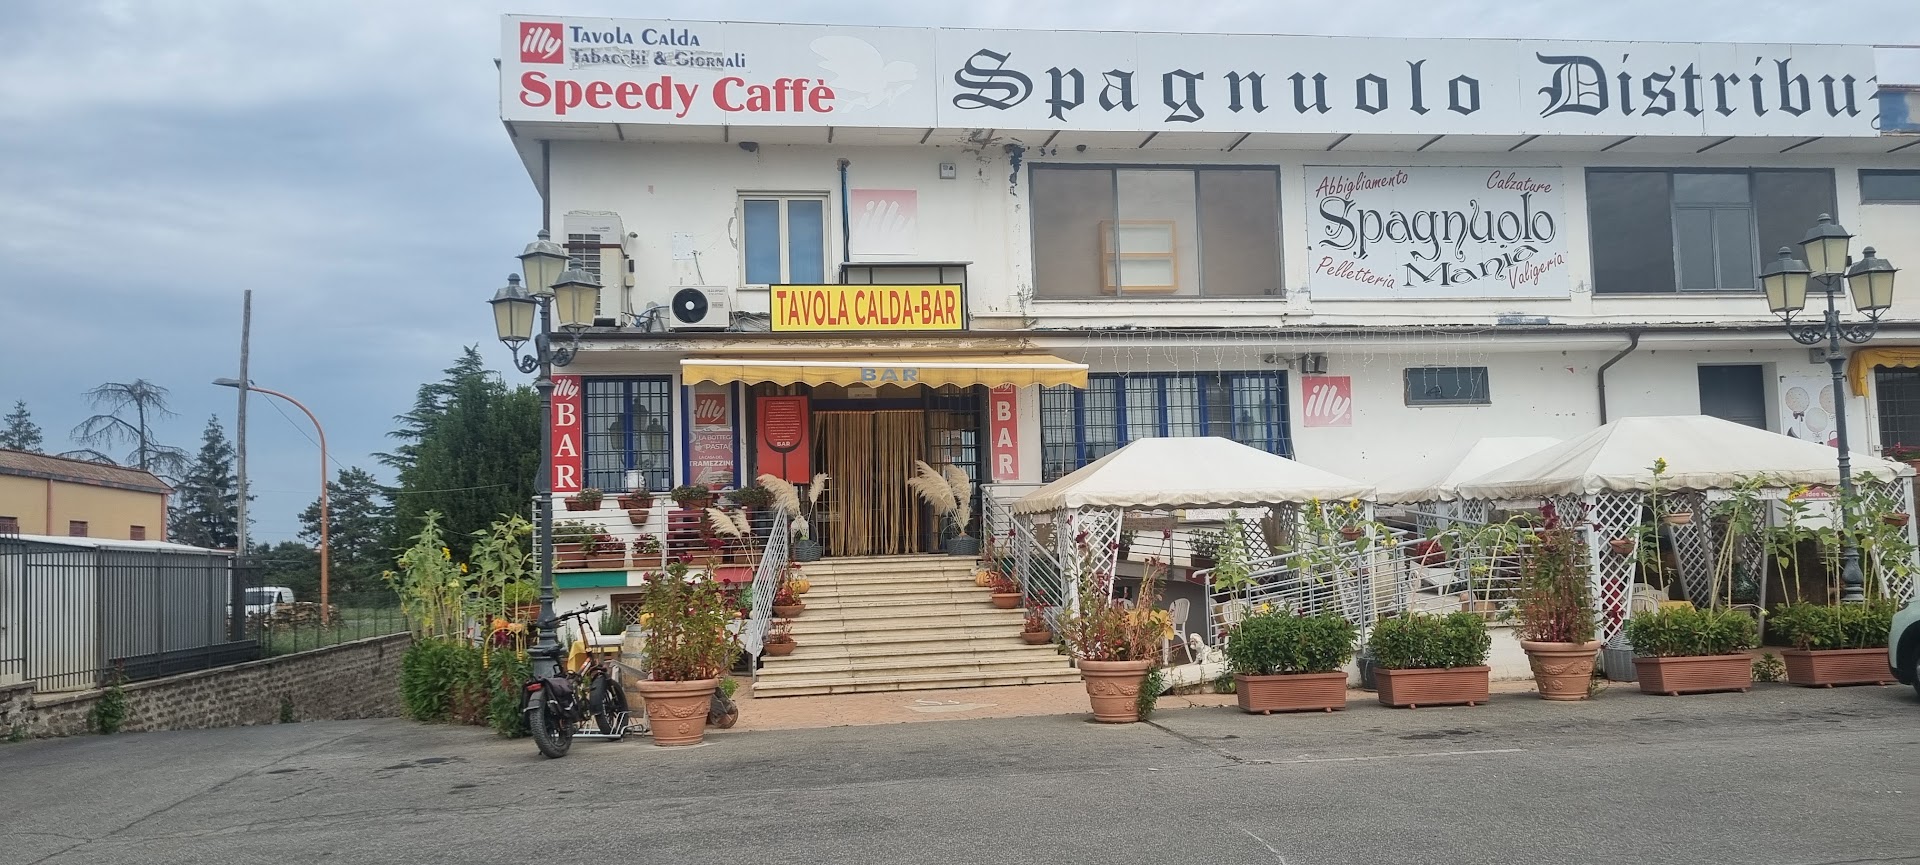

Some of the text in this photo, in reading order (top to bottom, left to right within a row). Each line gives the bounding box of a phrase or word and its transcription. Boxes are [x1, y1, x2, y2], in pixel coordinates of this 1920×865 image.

[521, 26, 562, 60] illy
[569, 26, 700, 47] Tavola Calda
[653, 50, 667, 66] &
[519, 70, 836, 119] Speedy Caffè
[952, 47, 1881, 130] Spagnuolo Distribu
[1315, 169, 1552, 200] Abbigliamento Calzature
[1318, 191, 1557, 262] Spagnuolo
[1315, 255, 1395, 290] Pelletteria
[1402, 243, 1539, 288] Mania
[1508, 252, 1565, 290] Valigeria
[776, 289, 957, 326] TAVOLA CALDA-BAR
[552, 378, 579, 401] illy
[860, 367, 918, 382] BAR
[696, 398, 725, 423] illy
[1305, 383, 1351, 424] illy
[554, 403, 579, 489] BAR
[996, 401, 1014, 475] BAR
